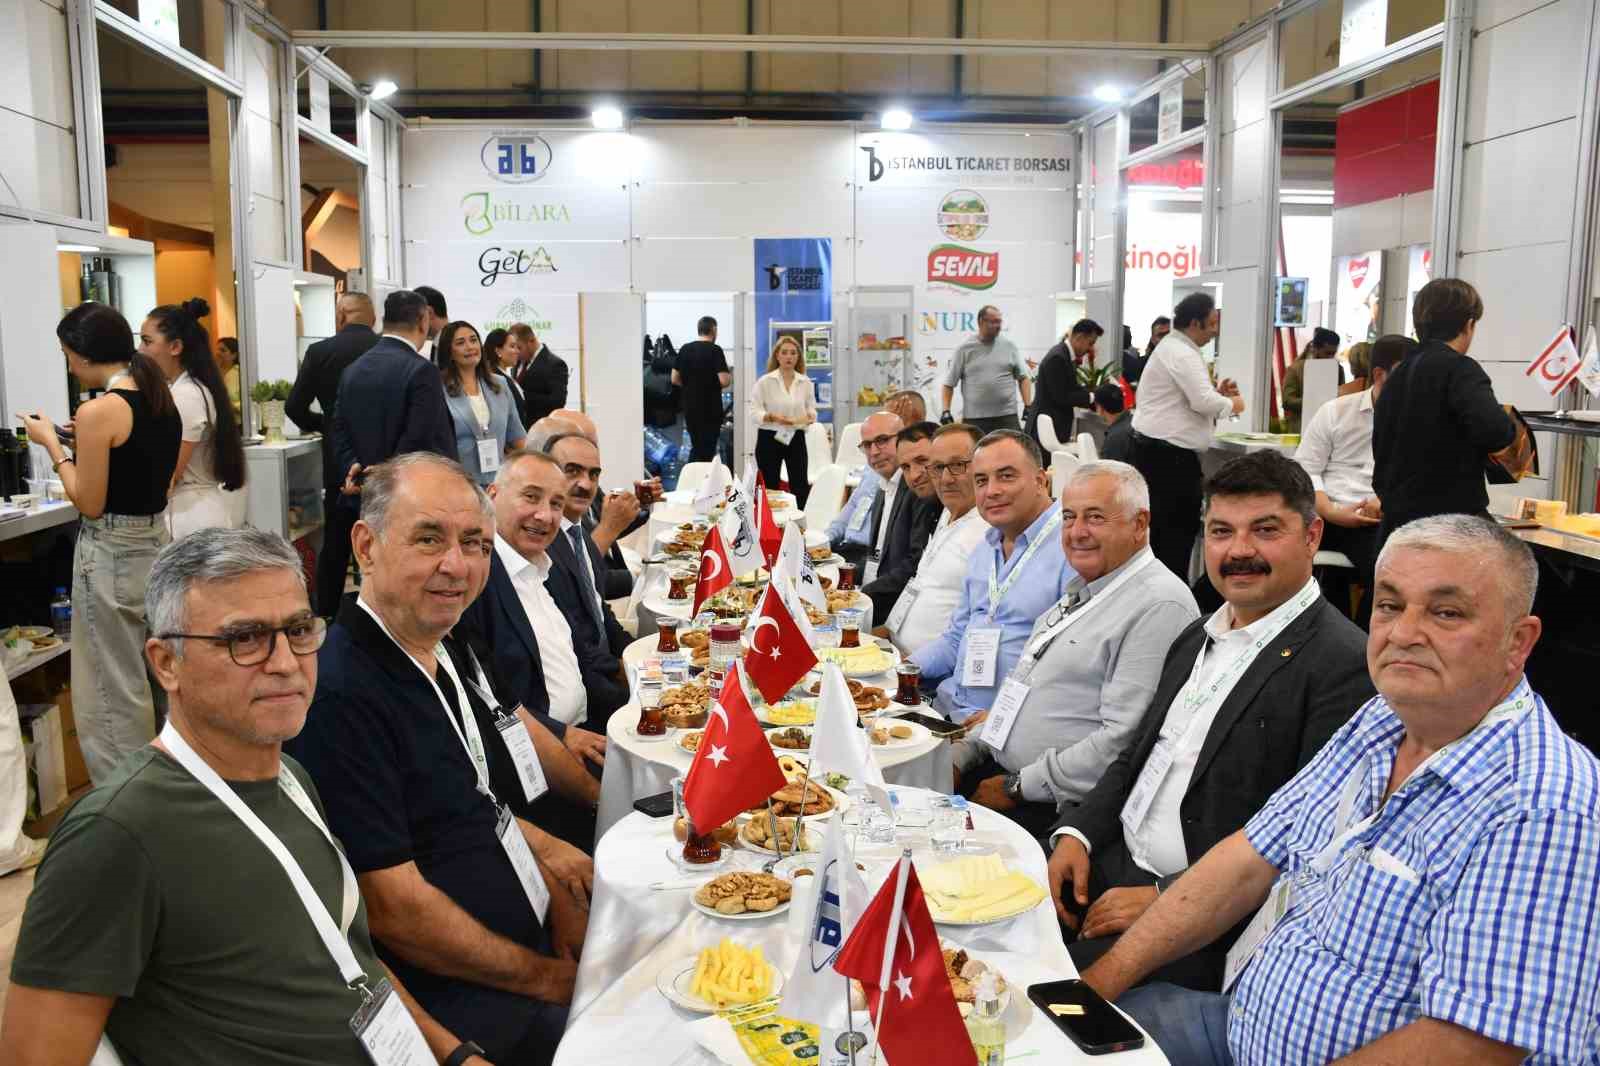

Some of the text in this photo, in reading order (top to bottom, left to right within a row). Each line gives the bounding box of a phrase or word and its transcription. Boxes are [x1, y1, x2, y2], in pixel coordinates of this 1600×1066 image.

[888, 153, 1071, 173] İSTANBUL TİCARET BORSASI
[494, 199, 571, 222] BİLARA
[931, 255, 995, 278] SEVAL
